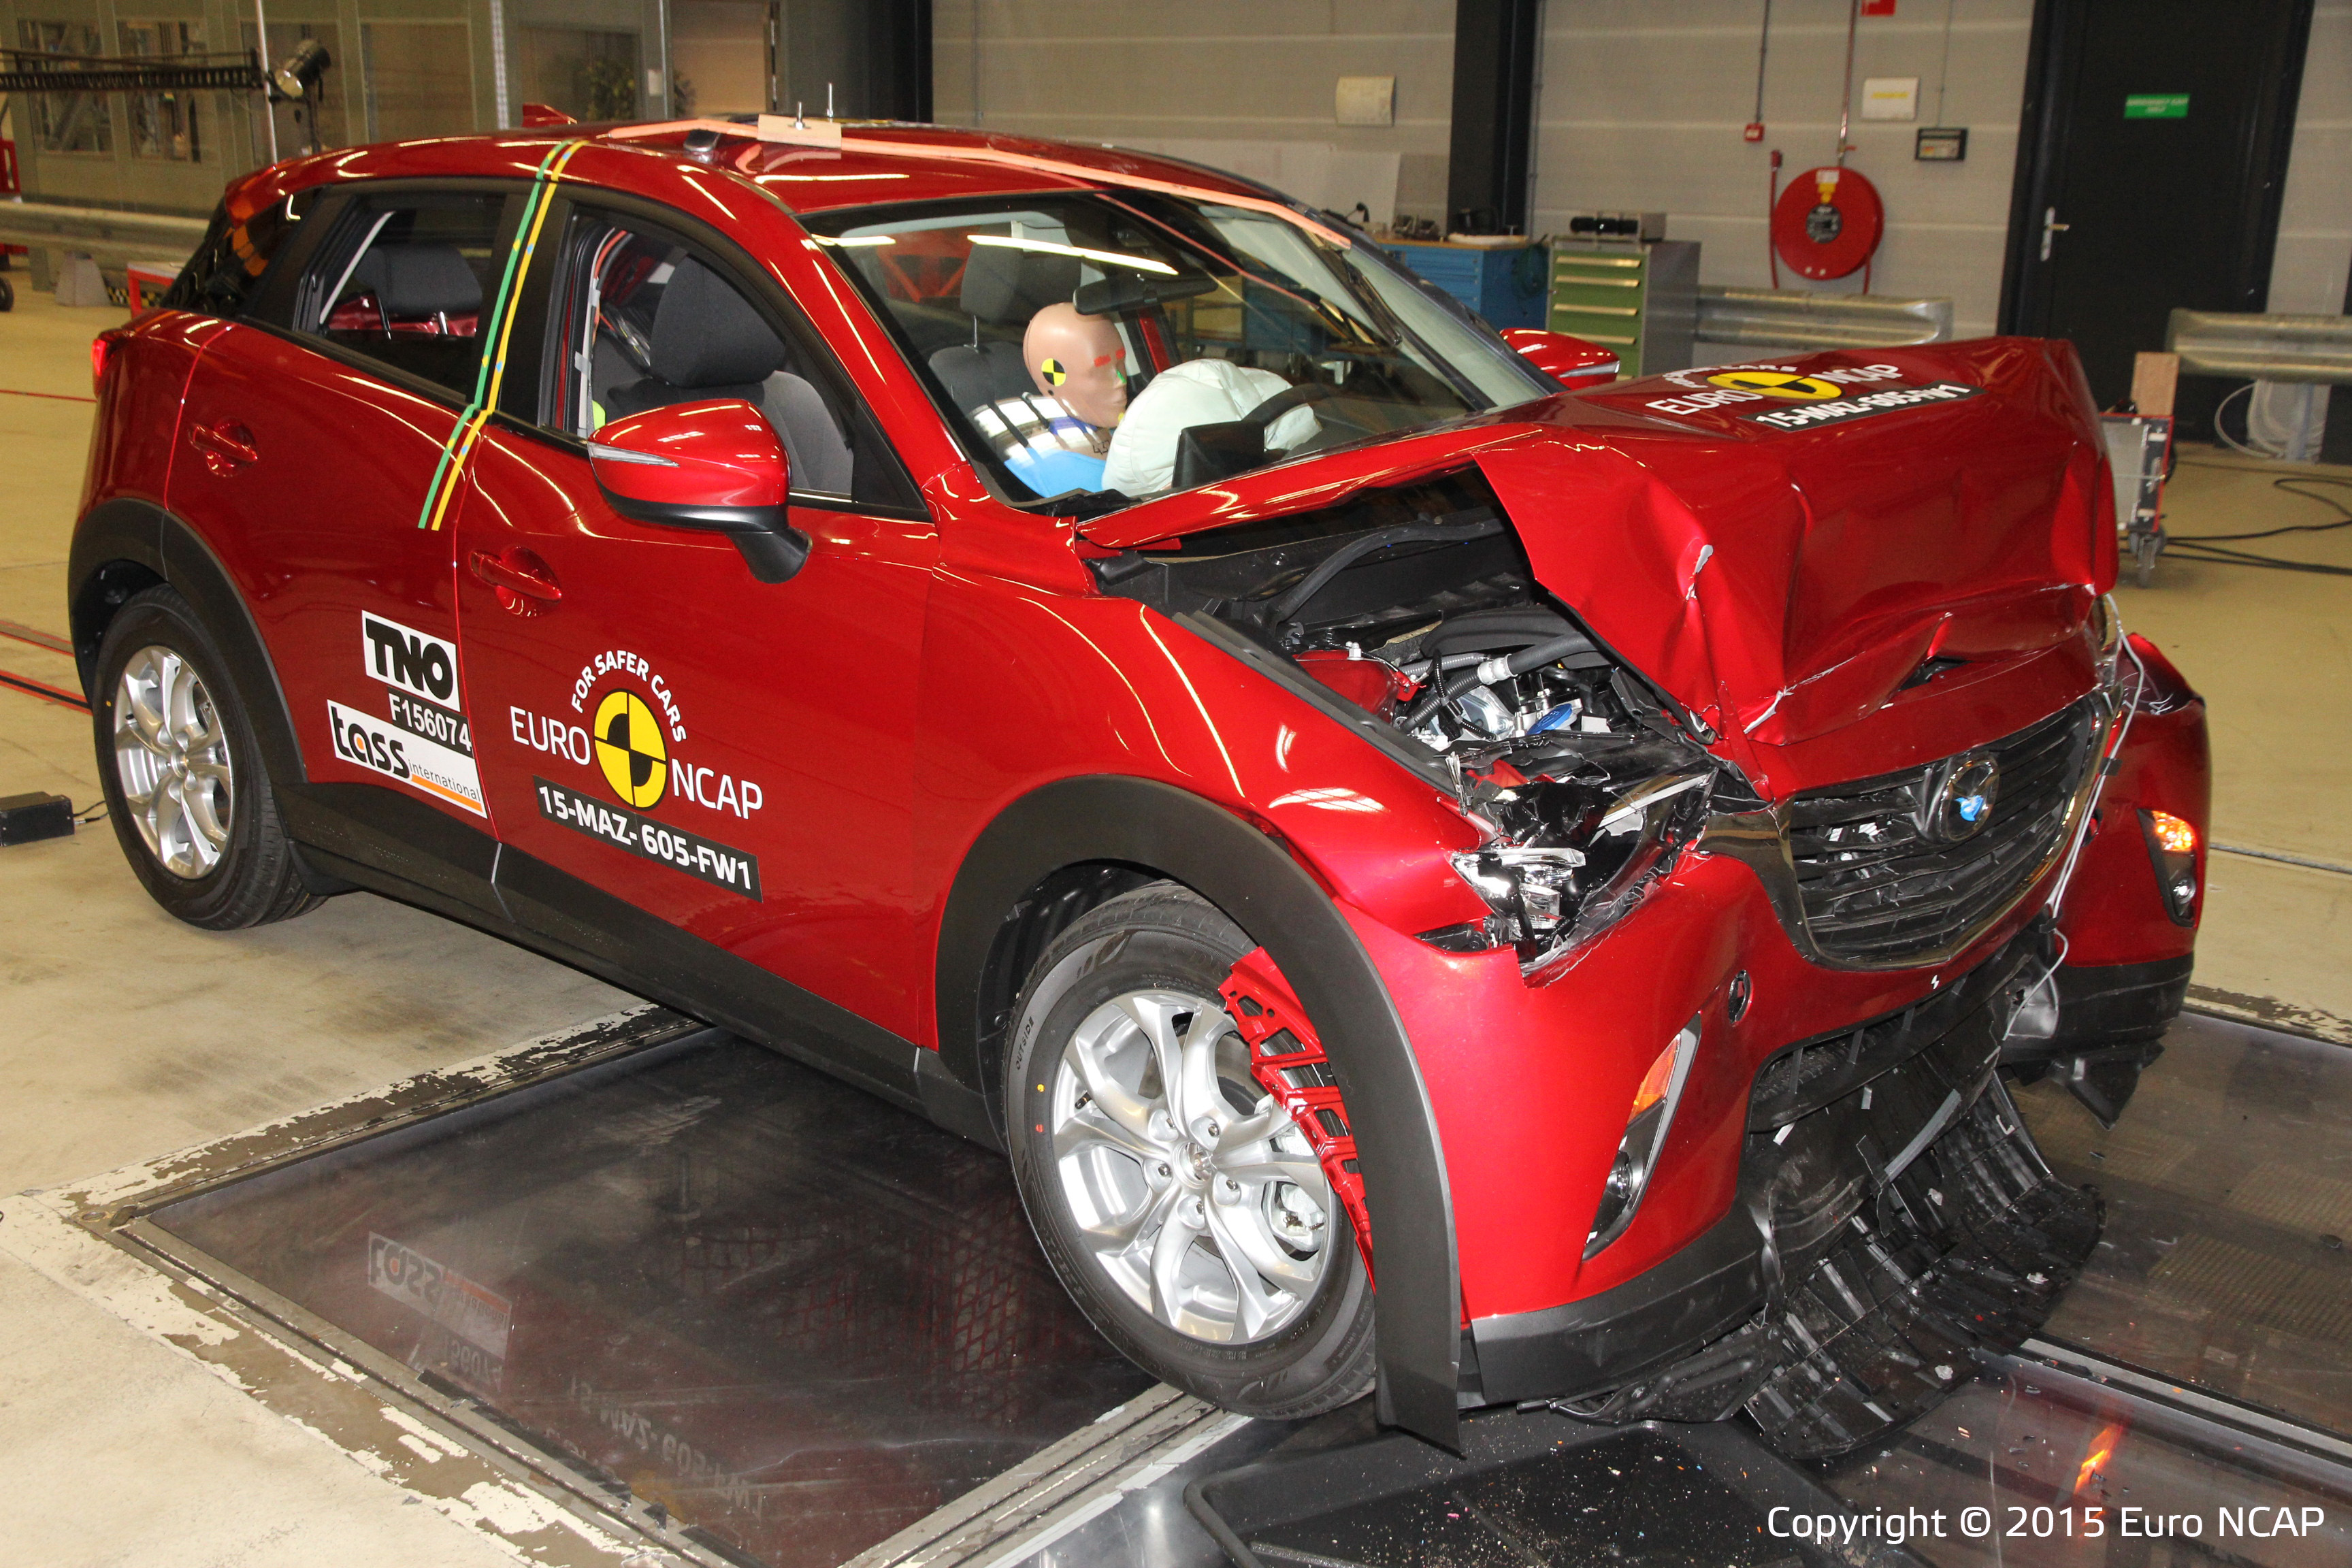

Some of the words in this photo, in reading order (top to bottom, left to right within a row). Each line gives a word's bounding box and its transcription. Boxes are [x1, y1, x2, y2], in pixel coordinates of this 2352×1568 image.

[1645, 389, 1764, 415] EURO
[1809, 364, 1903, 385] NCAP
[365, 618, 453, 700] TNO
[572, 666, 597, 713] FOR
[594, 650, 650, 682] SAFER
[651, 674, 687, 743] CARS
[331, 706, 410, 779] tass
[408, 759, 480, 802] international
[389, 693, 472, 751] F156074
[510, 705, 591, 766] EURO
[672, 758, 764, 820] NCAP
[1016, 1016, 1034, 1070] OUTSIDE
